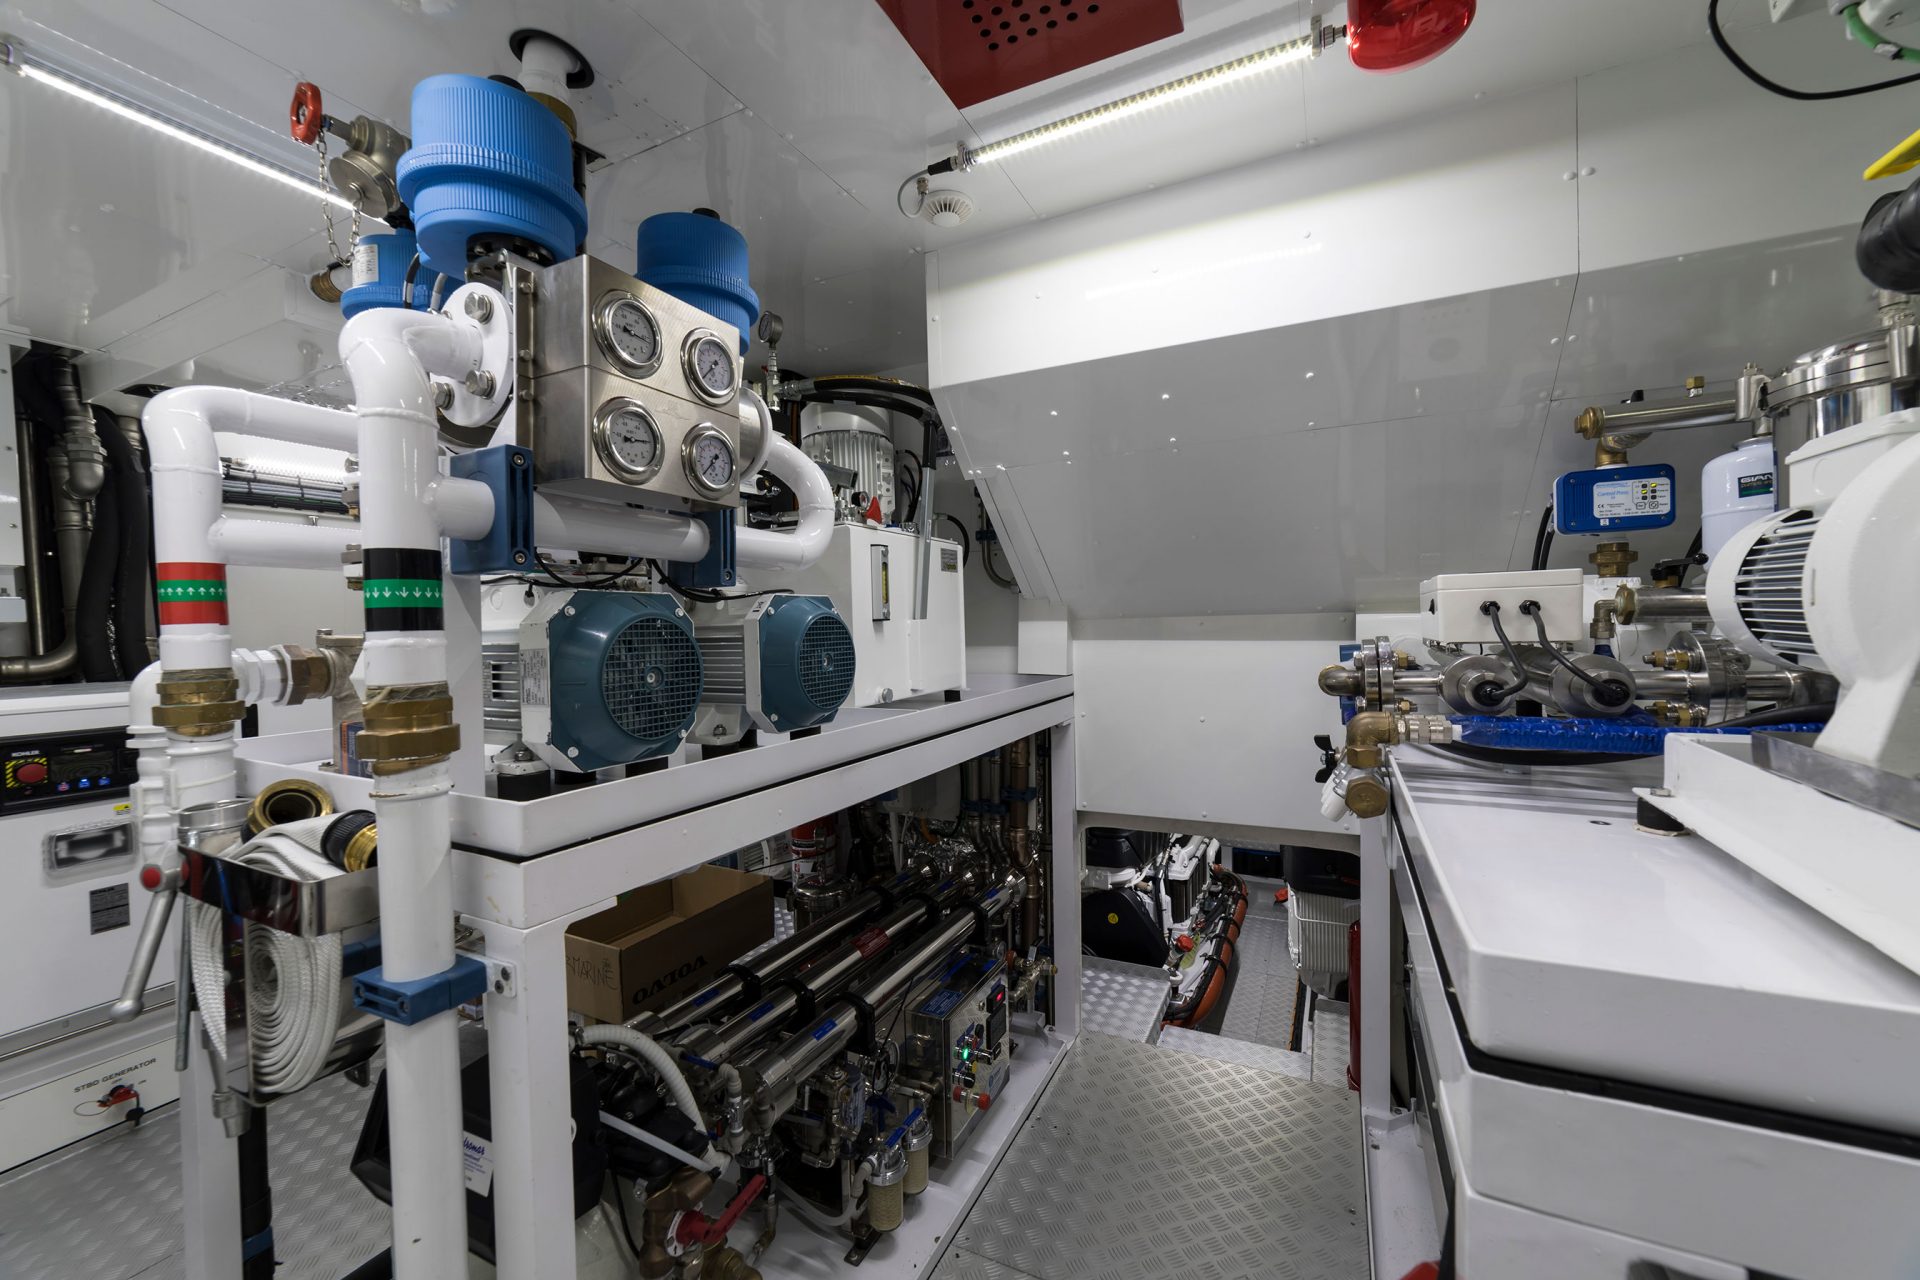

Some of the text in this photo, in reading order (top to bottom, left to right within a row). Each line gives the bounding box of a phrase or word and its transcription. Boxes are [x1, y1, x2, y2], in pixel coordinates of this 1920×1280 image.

[632, 955, 708, 1004] VOLVO
[73, 1079, 100, 1093] STBD
[101, 1058, 157, 1083] GENERATOR
